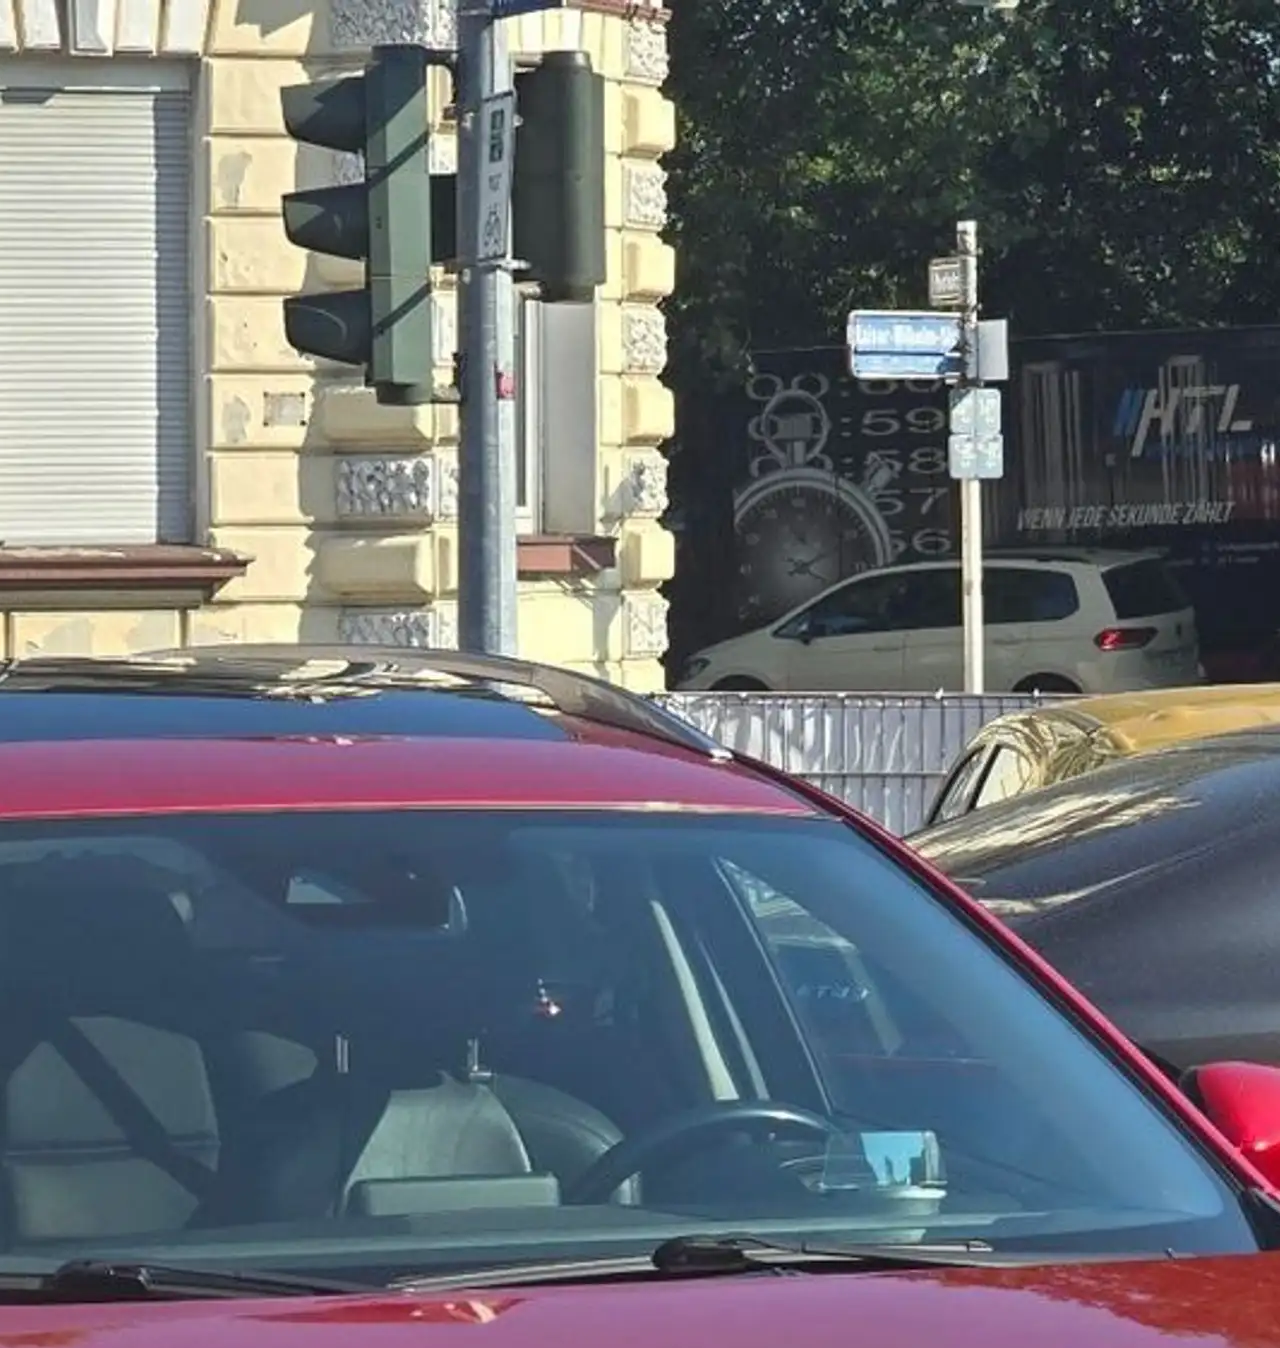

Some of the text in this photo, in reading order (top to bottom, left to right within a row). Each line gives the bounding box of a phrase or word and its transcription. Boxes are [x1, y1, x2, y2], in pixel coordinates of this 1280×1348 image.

[1131, 384, 1252, 457] HTL
[1067, 506, 1106, 530] JEDE
[1107, 503, 1181, 526] SEKUNDE
